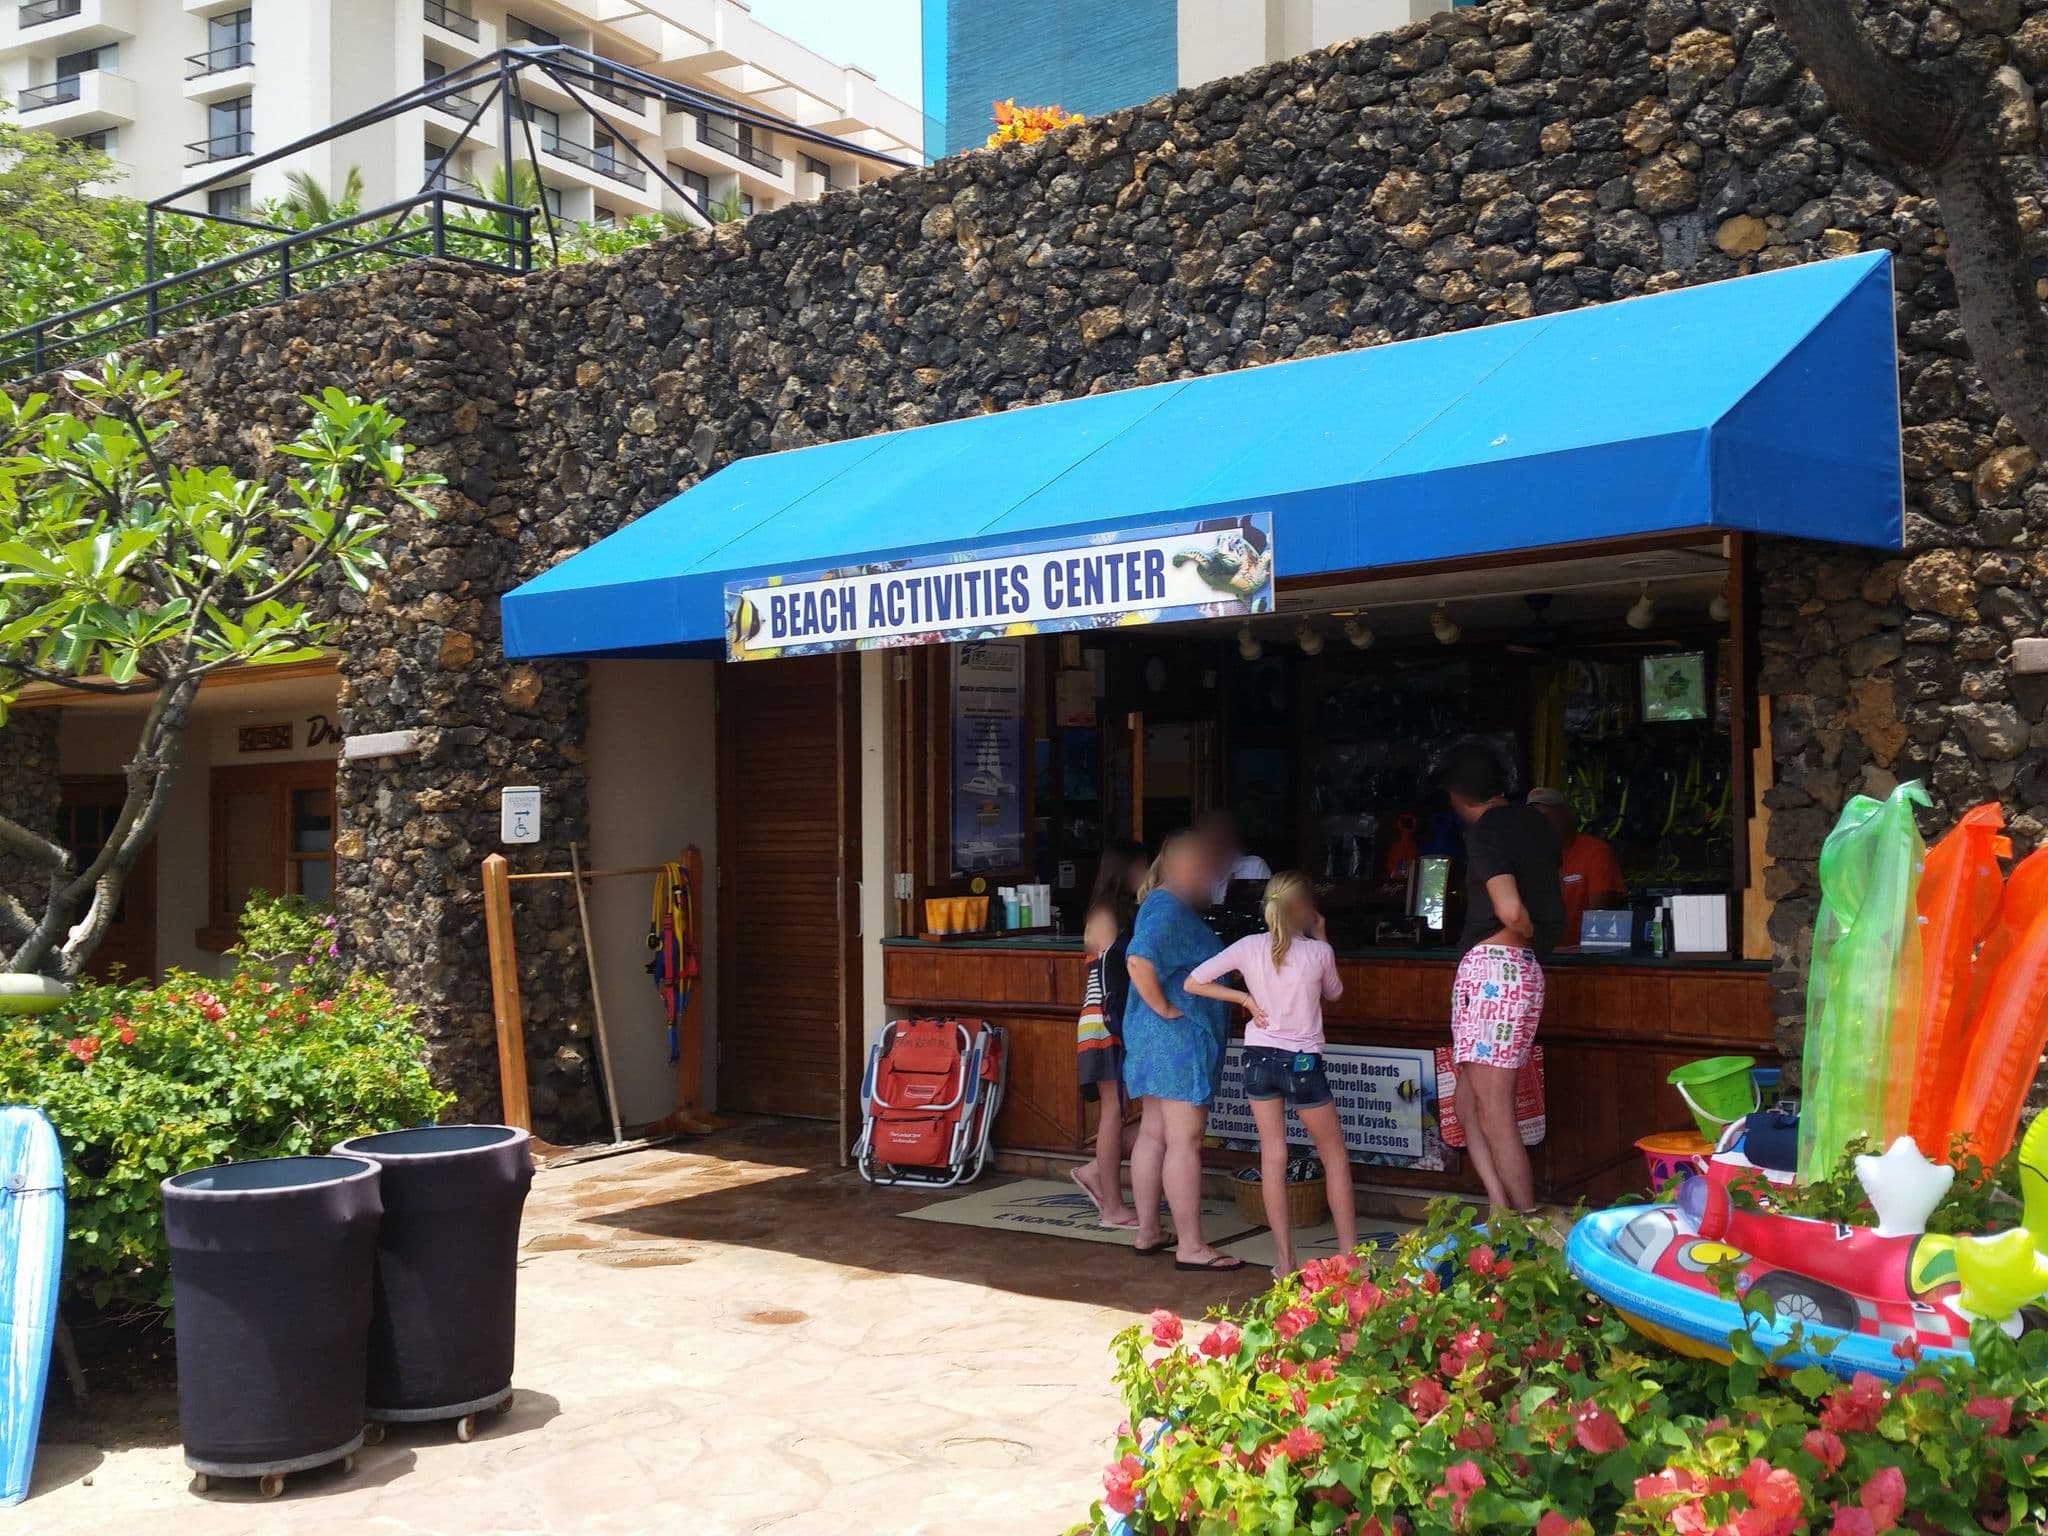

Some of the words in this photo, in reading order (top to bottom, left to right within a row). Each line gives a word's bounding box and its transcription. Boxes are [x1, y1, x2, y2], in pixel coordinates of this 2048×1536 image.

[770, 583, 858, 639] BEACH
[867, 564, 1030, 630] ACTIVITIES
[1042, 548, 1167, 611] CENTER
[1319, 1060, 1358, 1075] Boogie
[1360, 1063, 1400, 1078] Boards
[1327, 1079, 1377, 1093] mbrellas
[1357, 1097, 1392, 1113] Diving
[1211, 1117, 1260, 1133] Catamara
[1357, 1114, 1397, 1130] Kayaks
[1364, 1132, 1409, 1148] Lessons
